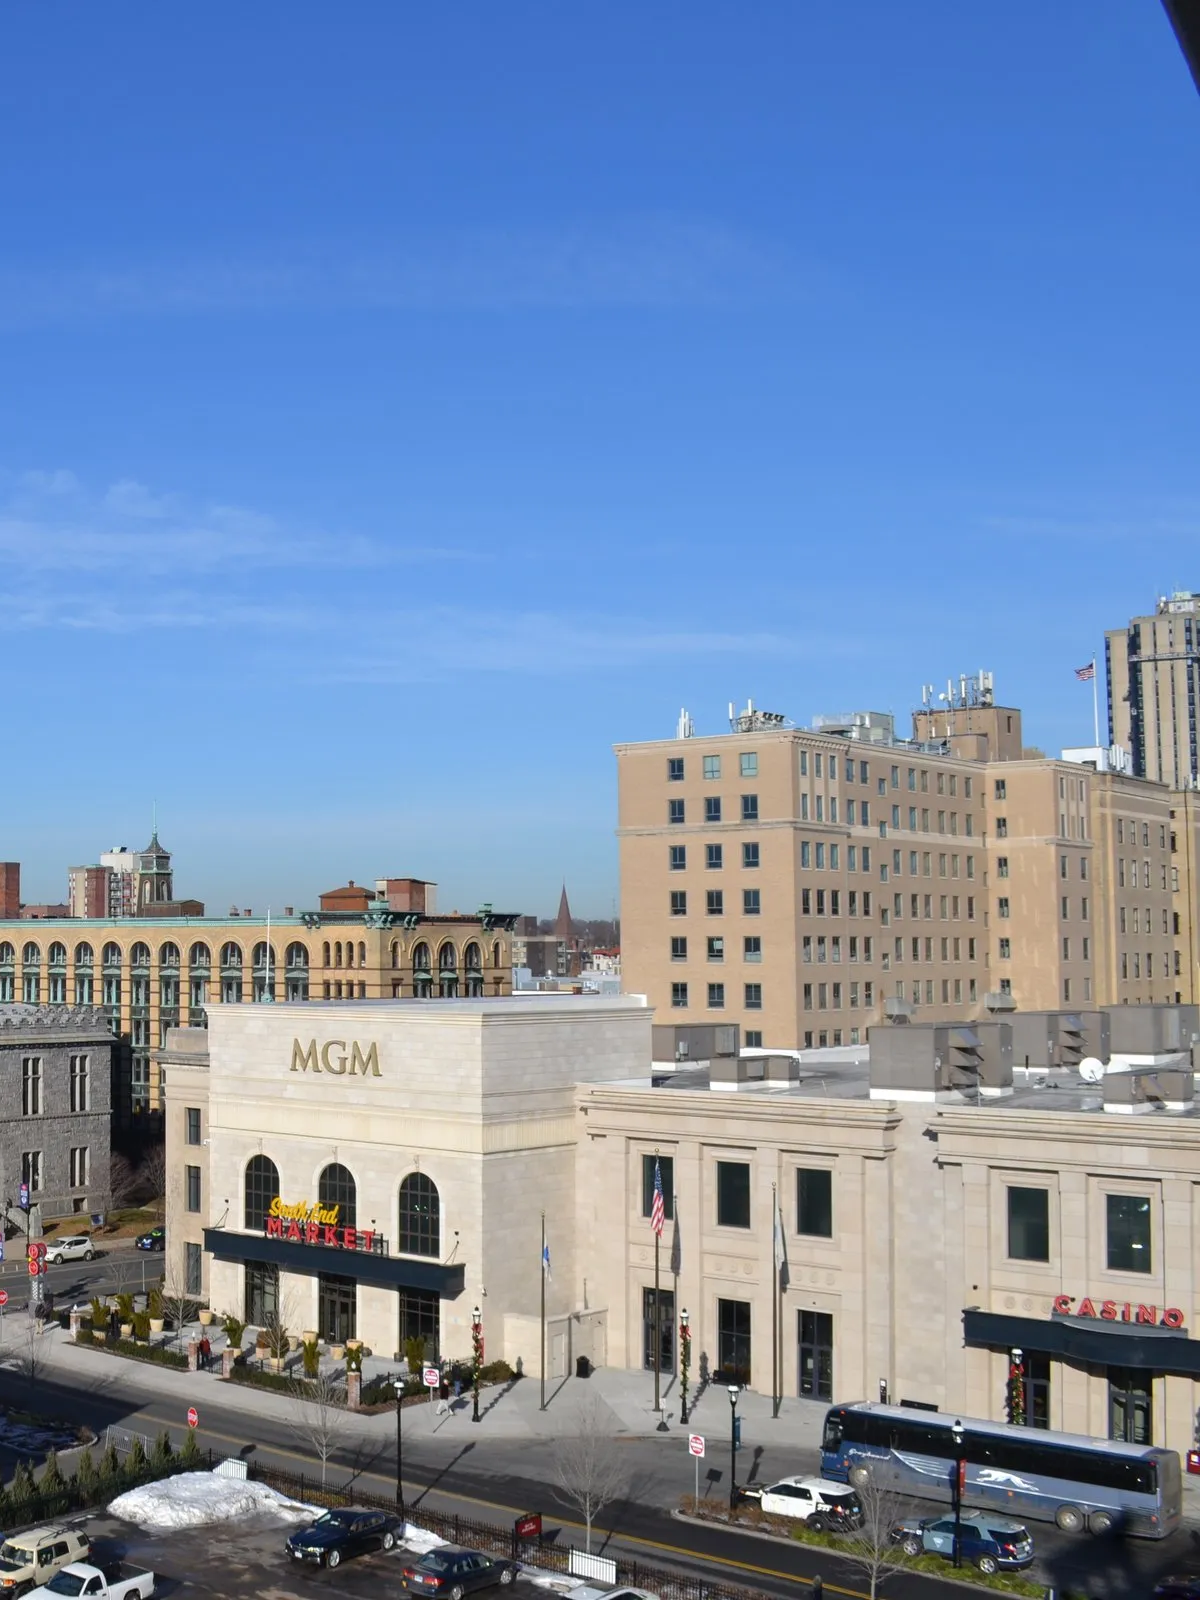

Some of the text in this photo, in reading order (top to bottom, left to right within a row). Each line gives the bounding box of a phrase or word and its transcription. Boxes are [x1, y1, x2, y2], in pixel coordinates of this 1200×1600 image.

[289, 1037, 383, 1077] MGM
[268, 1197, 340, 1226] South End
[266, 1216, 377, 1252] MARKET
[1053, 1294, 1185, 1329] CASINO
